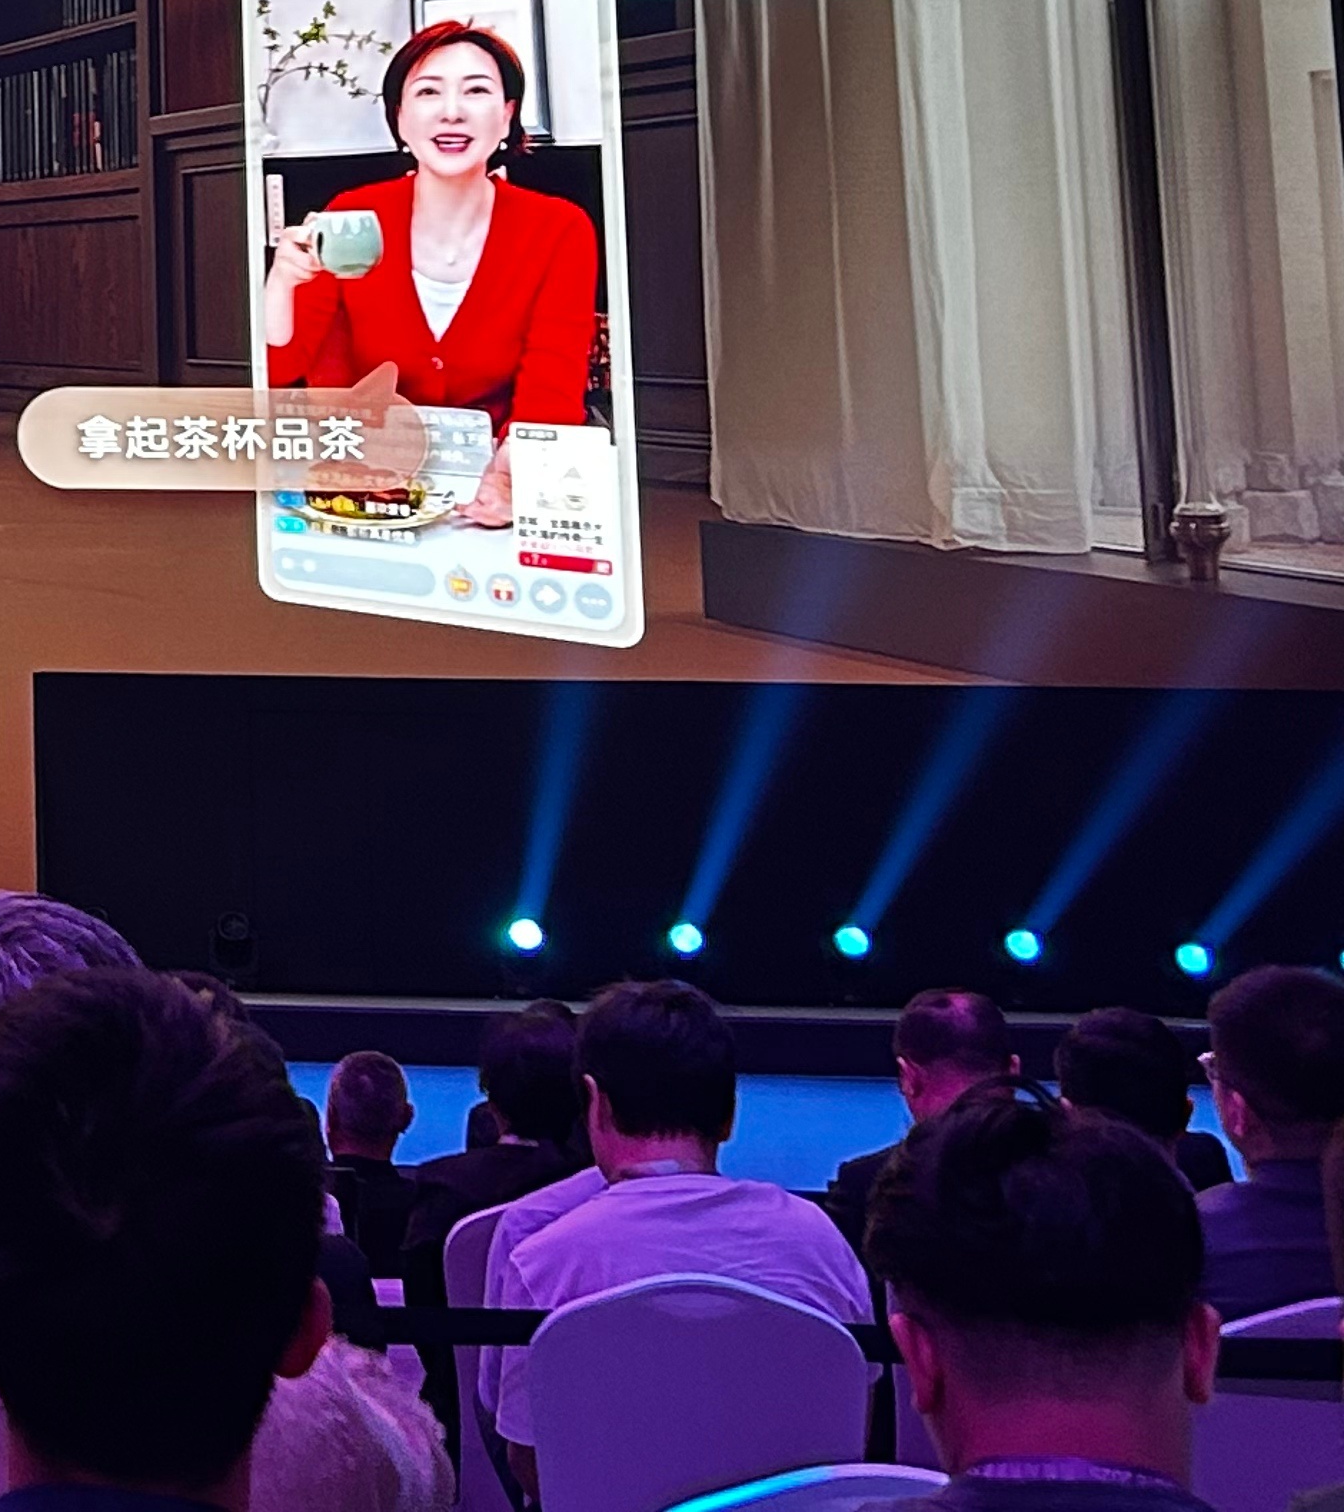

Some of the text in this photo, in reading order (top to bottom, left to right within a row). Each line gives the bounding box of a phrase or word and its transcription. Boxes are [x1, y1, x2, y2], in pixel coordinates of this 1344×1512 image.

[75, 414, 366, 461] 拿起茶杯品茶
